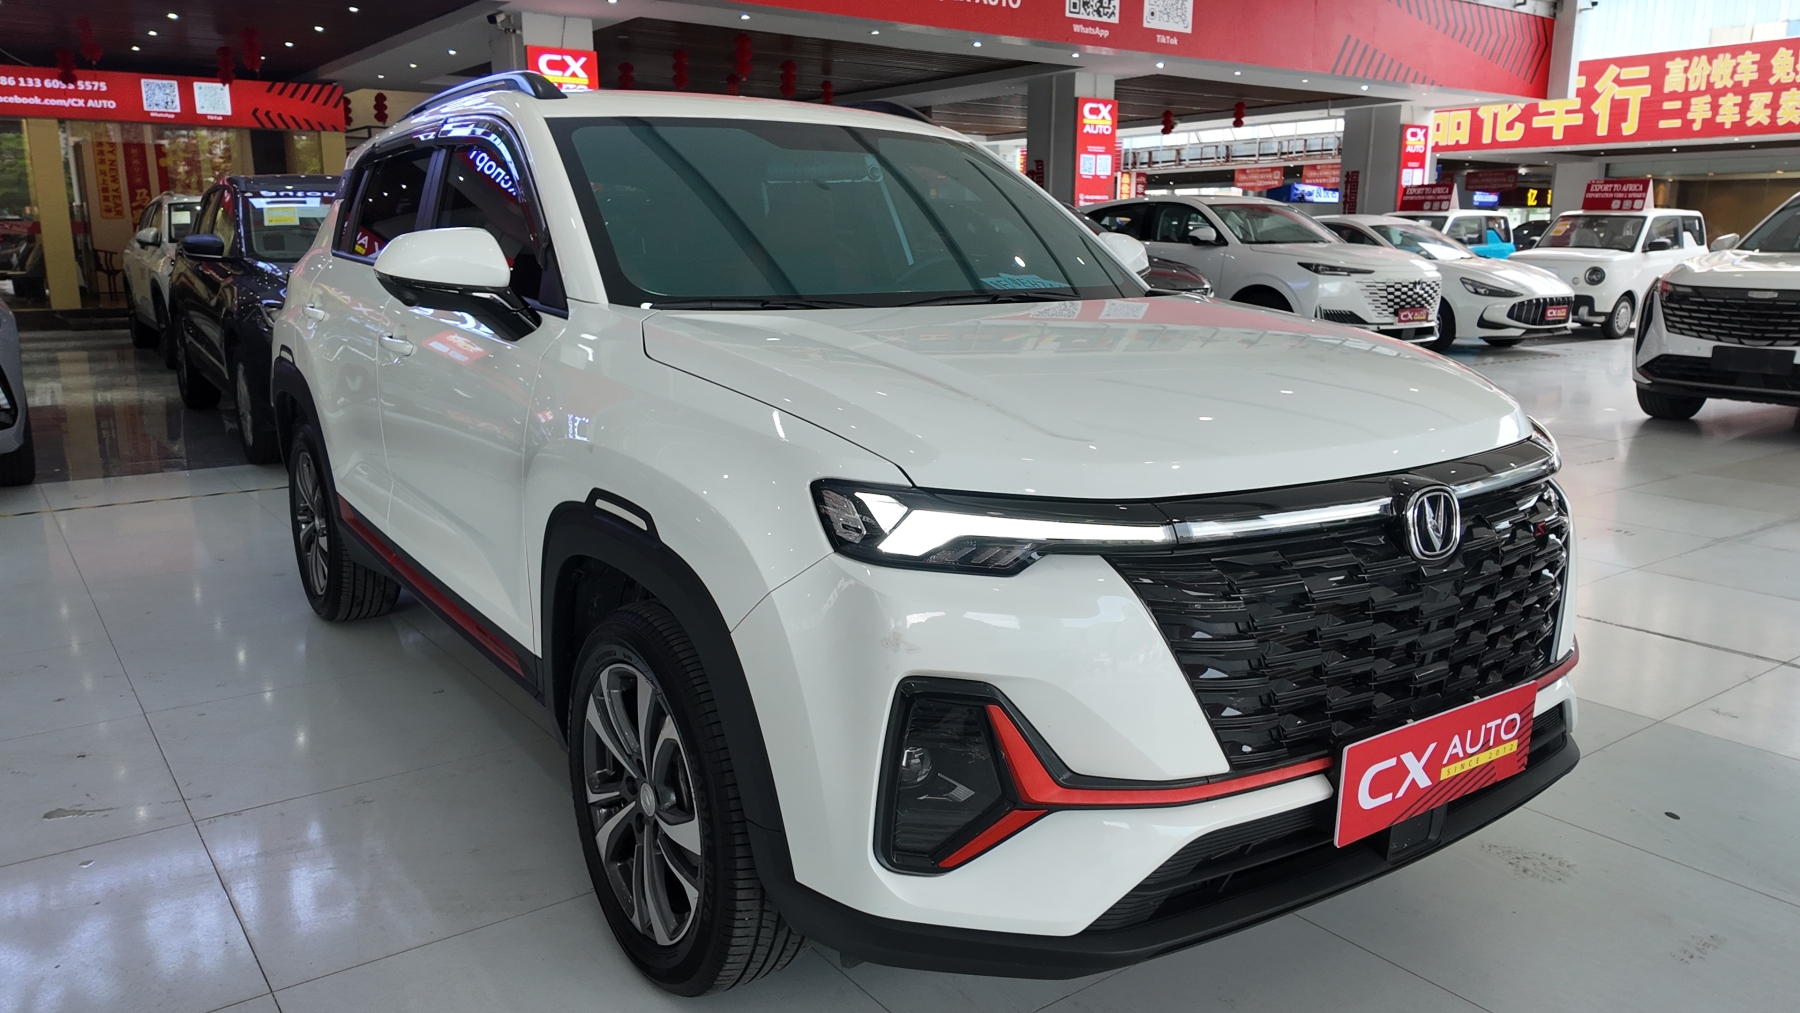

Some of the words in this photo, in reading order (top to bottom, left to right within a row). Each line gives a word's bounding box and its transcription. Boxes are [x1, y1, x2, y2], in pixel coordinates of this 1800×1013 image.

[1073, 24, 1109, 38] WhatsApp
[1156, 35, 1178, 45] TikTok
[538, 54, 588, 78] CX
[1663, 50, 1760, 93] 高价收车
[1768, 47, 1800, 85] 免
[18, 77, 42, 88] 133
[77, 81, 107, 91] 5575
[87, 99, 117, 109] AUTO
[1083, 103, 1112, 120] CX
[1083, 125, 1112, 134] AUTO
[1406, 128, 1425, 141] CX
[1406, 145, 1425, 153] AUTO
[1400, 311, 1414, 320] CX
[1358, 741, 1438, 810] CX
[1442, 713, 1521, 764] AUTO
[1446, 756, 1480, 776] SINCE
[1488, 743, 1514, 760] 2012
